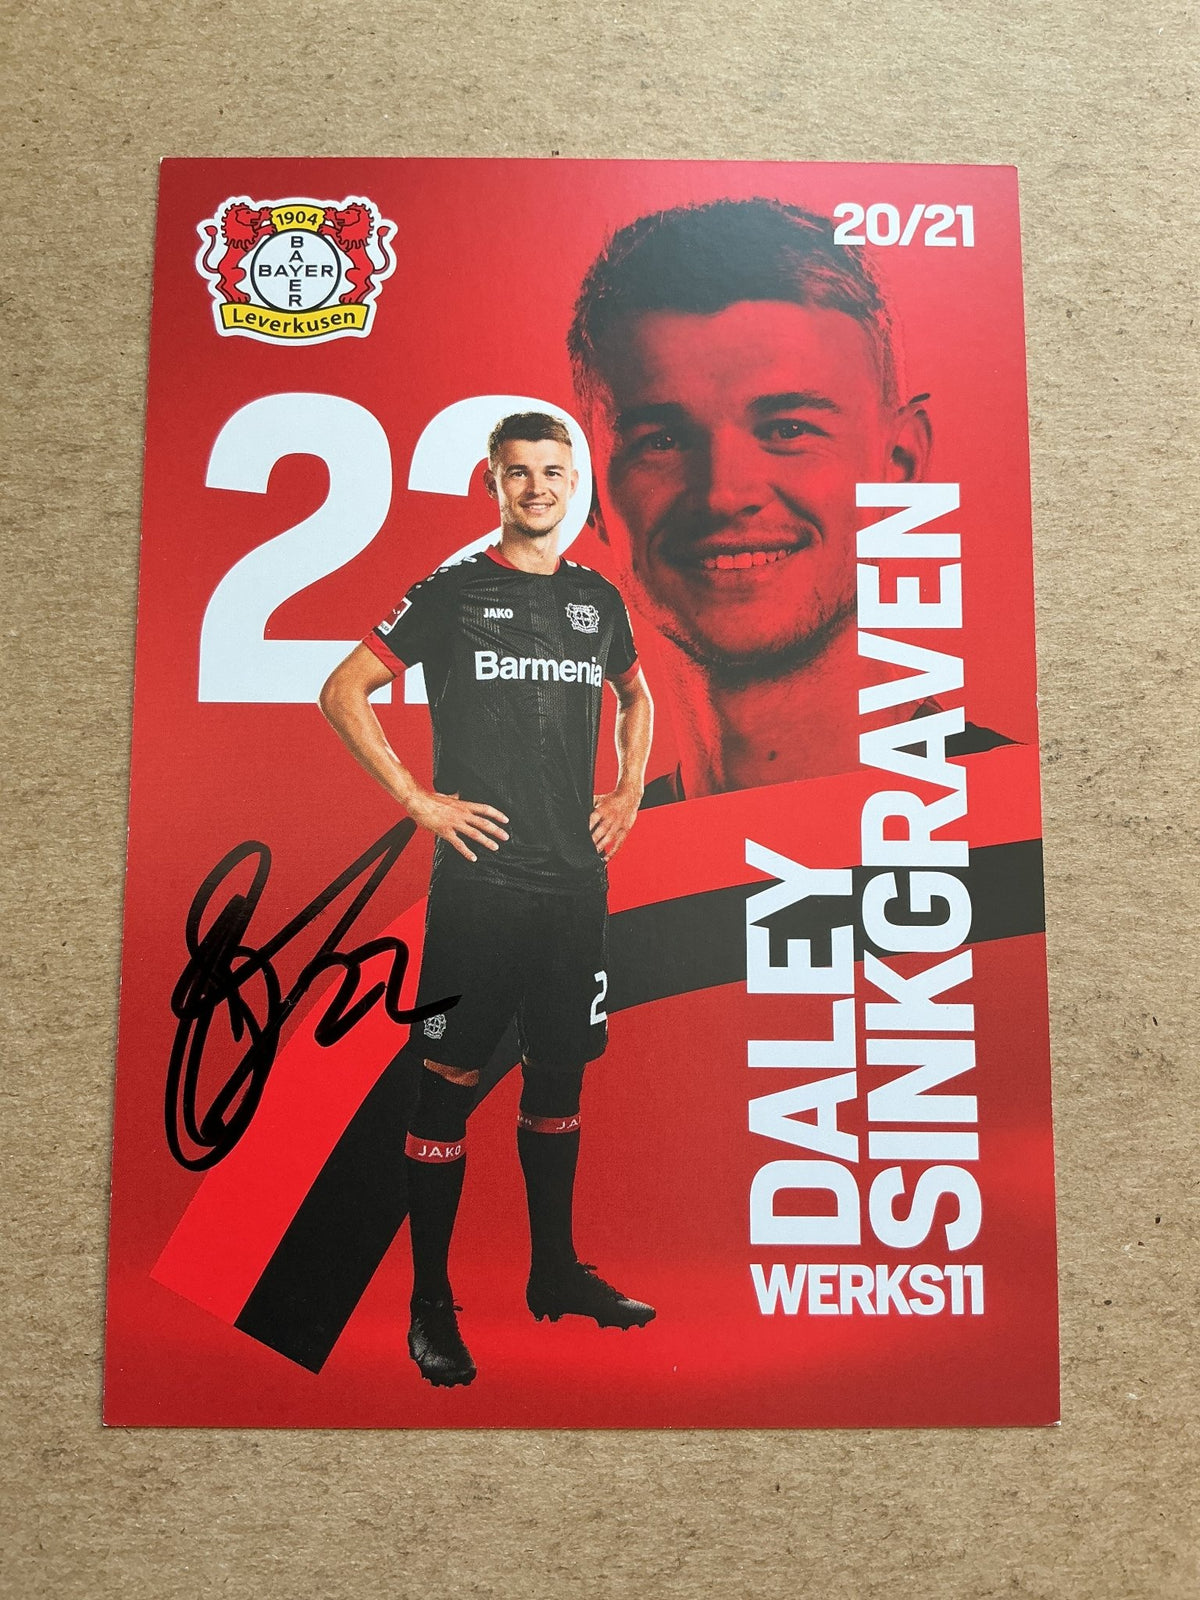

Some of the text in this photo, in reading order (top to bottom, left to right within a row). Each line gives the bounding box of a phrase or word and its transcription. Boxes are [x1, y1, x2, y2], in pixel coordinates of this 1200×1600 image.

[275, 211, 319, 226] 1904
[833, 202, 975, 247] 20/21
[258, 264, 334, 277] BAYER
[289, 236, 304, 307] BAYER
[233, 308, 356, 333] Leverkusen
[197, 392, 593, 704] 22
[483, 608, 514, 619] JAKO
[474, 650, 602, 687] Barmenia
[855, 482, 983, 1251] SINKGRAVEN
[745, 838, 862, 1246] DALEY
[418, 1144, 462, 1158] JAKO
[750, 1264, 985, 1315] WERKS11
